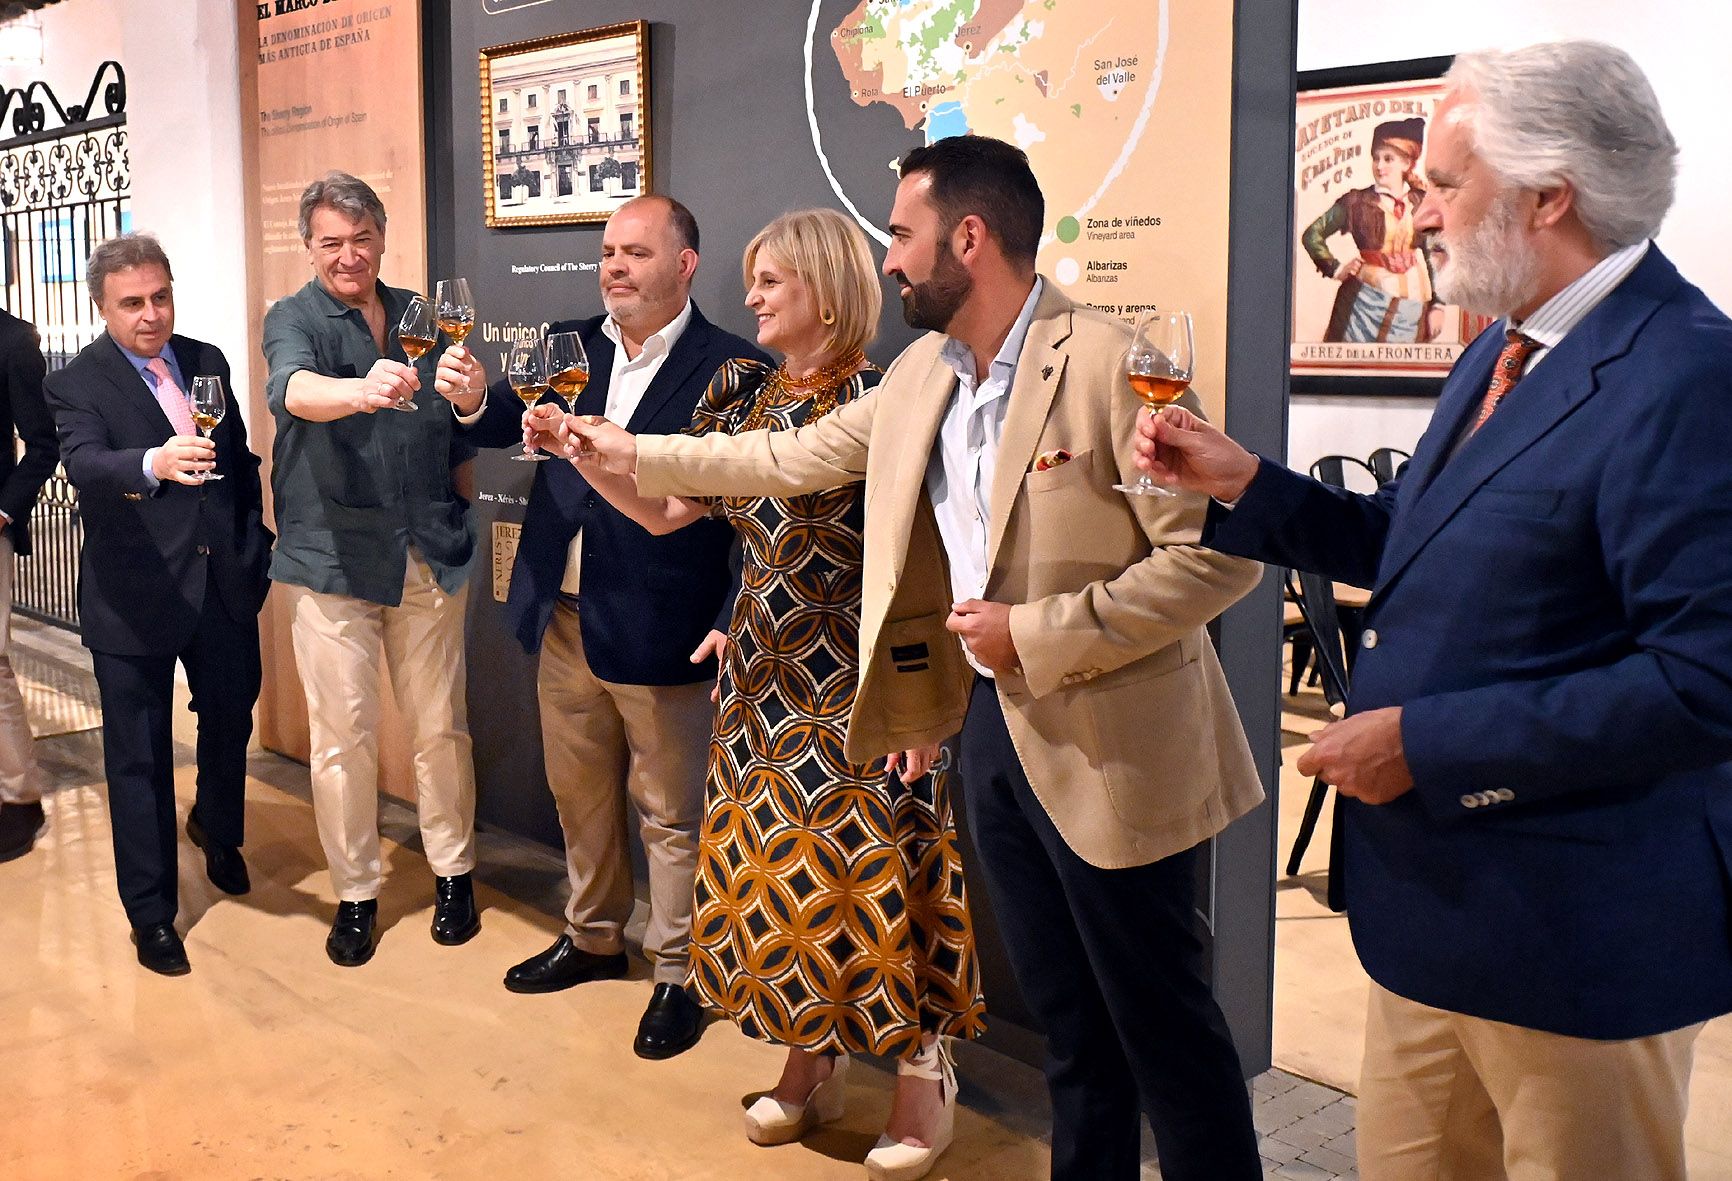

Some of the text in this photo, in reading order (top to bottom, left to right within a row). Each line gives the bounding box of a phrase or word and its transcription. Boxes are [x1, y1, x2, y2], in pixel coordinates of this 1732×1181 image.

[256, 3, 271, 20] EL
[258, 36, 268, 48] LA
[341, 14, 354, 28] DE
[840, 25, 873, 38] Chipiona
[955, 25, 981, 38] Jerez
[320, 38, 331, 51] DE
[1094, 54, 1138, 71] San José
[1096, 71, 1136, 85] del Valle
[861, 88, 878, 97] Rota
[903, 84, 945, 98] El Puerto
[1296, 101, 1386, 152] AYETANO
[1087, 215, 1161, 229] Zona de viñedos
[1087, 231, 1135, 242] Vineyard area
[540, 262, 560, 272] Council
[561, 262, 567, 271] of
[568, 262, 578, 271] The
[579, 261, 598, 272] Sherry
[1086, 260, 1128, 271] Albarizas
[1117, 304, 1123, 315] y
[482, 322, 500, 343] Un
[1301, 346, 1453, 360] JEREZ DE LA FRONTERA
